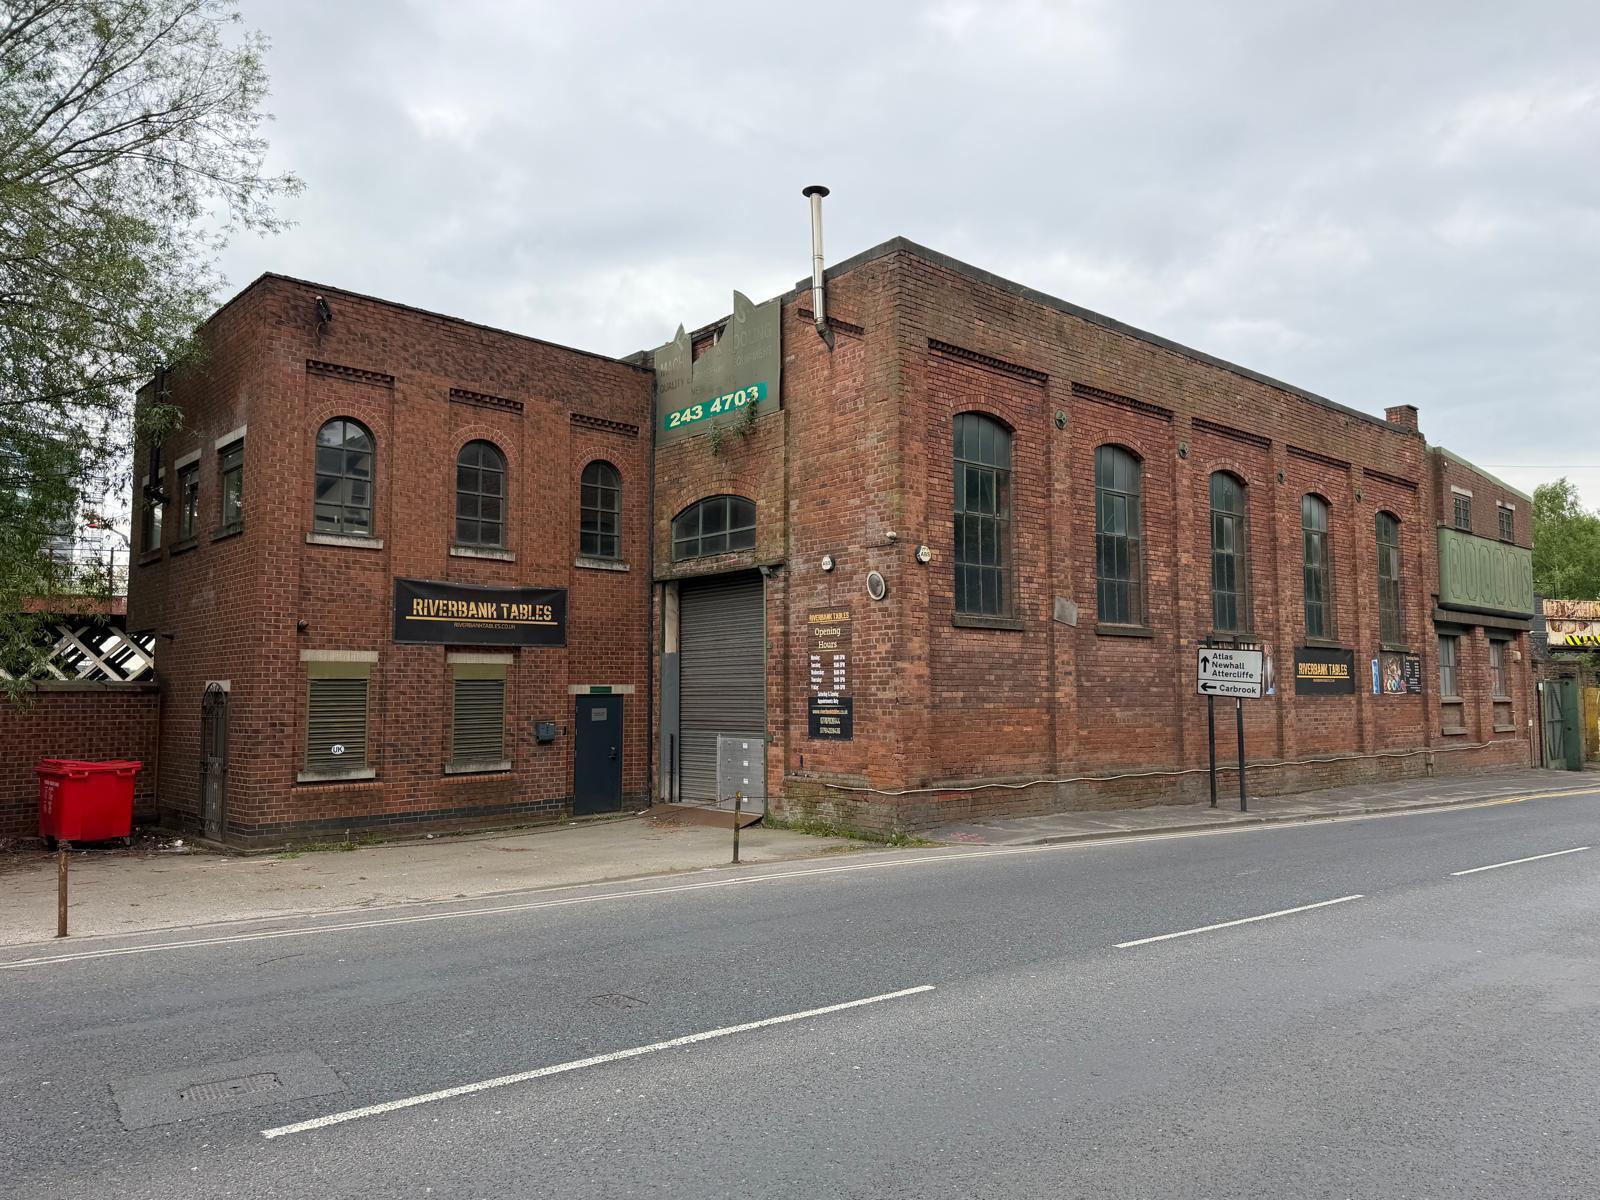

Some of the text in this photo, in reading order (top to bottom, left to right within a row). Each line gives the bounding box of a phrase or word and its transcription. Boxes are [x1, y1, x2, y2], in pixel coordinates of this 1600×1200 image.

[670, 405, 703, 427] 243
[710, 386, 759, 413] 4703
[413, 598, 552, 621] RIVERBANK TABLES
[814, 627, 840, 637] Opening
[818, 641, 837, 649] Hours
[1211, 661, 1245, 670] Newhall
[1298, 662, 1348, 676] RIVERBANK TABLES
[1211, 670, 1254, 679] Attercliffe
[1219, 684, 1257, 694] Carbrook
